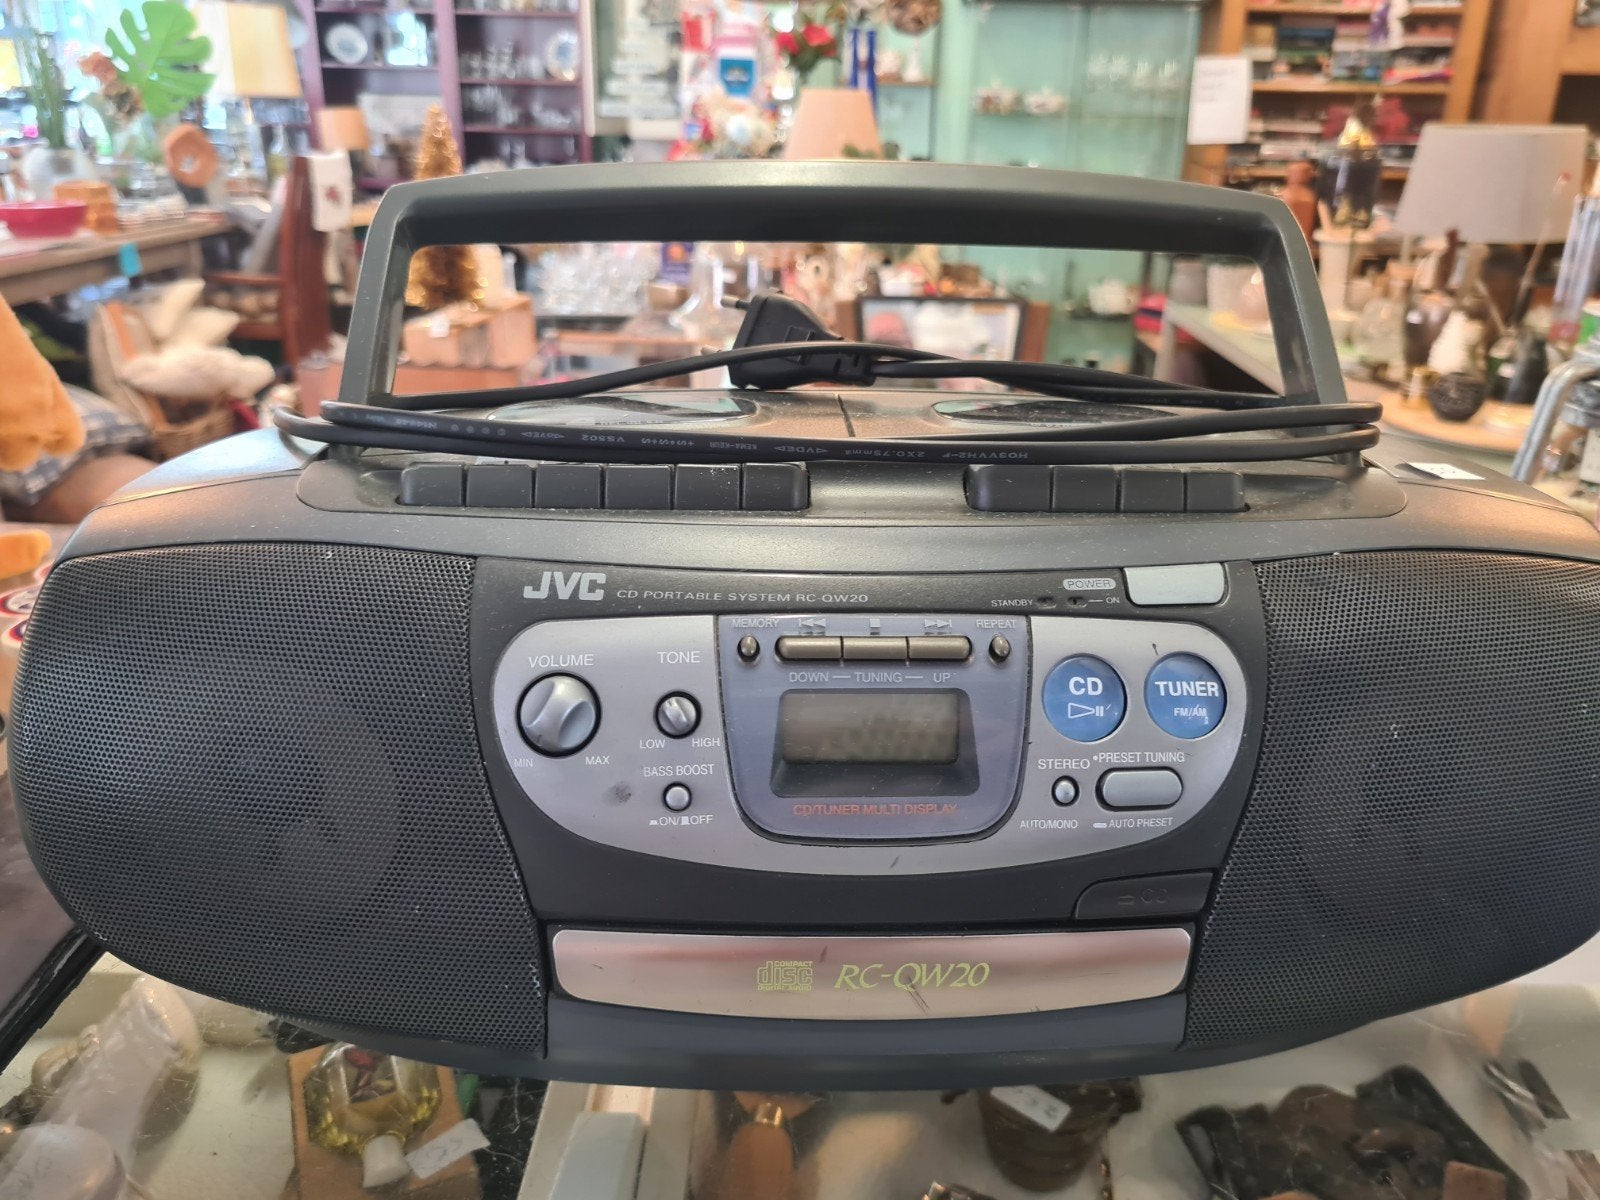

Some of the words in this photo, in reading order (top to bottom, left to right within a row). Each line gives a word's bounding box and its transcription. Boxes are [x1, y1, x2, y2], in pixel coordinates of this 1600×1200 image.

[523, 571, 607, 600] JVC
[617, 590, 638, 599] CD
[644, 591, 722, 601] PORTABLE
[728, 593, 790, 603] SYSTEM
[1067, 579, 1111, 589] POWER
[991, 598, 1033, 608] STANDBY
[1105, 596, 1120, 604] ON
[732, 618, 779, 628] MEMORY
[976, 619, 1016, 629] REPEAT
[528, 653, 594, 668] VOLUME
[657, 651, 700, 665] TONE
[789, 672, 829, 683] DOWN
[854, 672, 903, 683] TUNING
[933, 672, 951, 683] UP
[1068, 676, 1103, 697] CD
[1154, 680, 1219, 697] TUNER
[1173, 707, 1207, 717] FM/AM
[639, 739, 665, 750] LOW
[691, 737, 720, 748] HIGH
[514, 758, 533, 768] MIN
[585, 755, 610, 766] MAX
[1099, 752, 1142, 763] PRESET
[1144, 752, 1185, 763] TUNING
[1037, 758, 1090, 770] STEREO
[643, 766, 673, 777] BASS
[676, 764, 714, 776] BOOST
[793, 803, 859, 816] CD/TUNER
[863, 803, 901, 815] MULTI
[904, 803, 958, 816] DISPLAY
[1020, 819, 1078, 830] AUTO/MONO
[1109, 819, 1135, 829] AUTO
[1137, 818, 1173, 828] PRESET
[834, 962, 990, 991] RC-QW20
